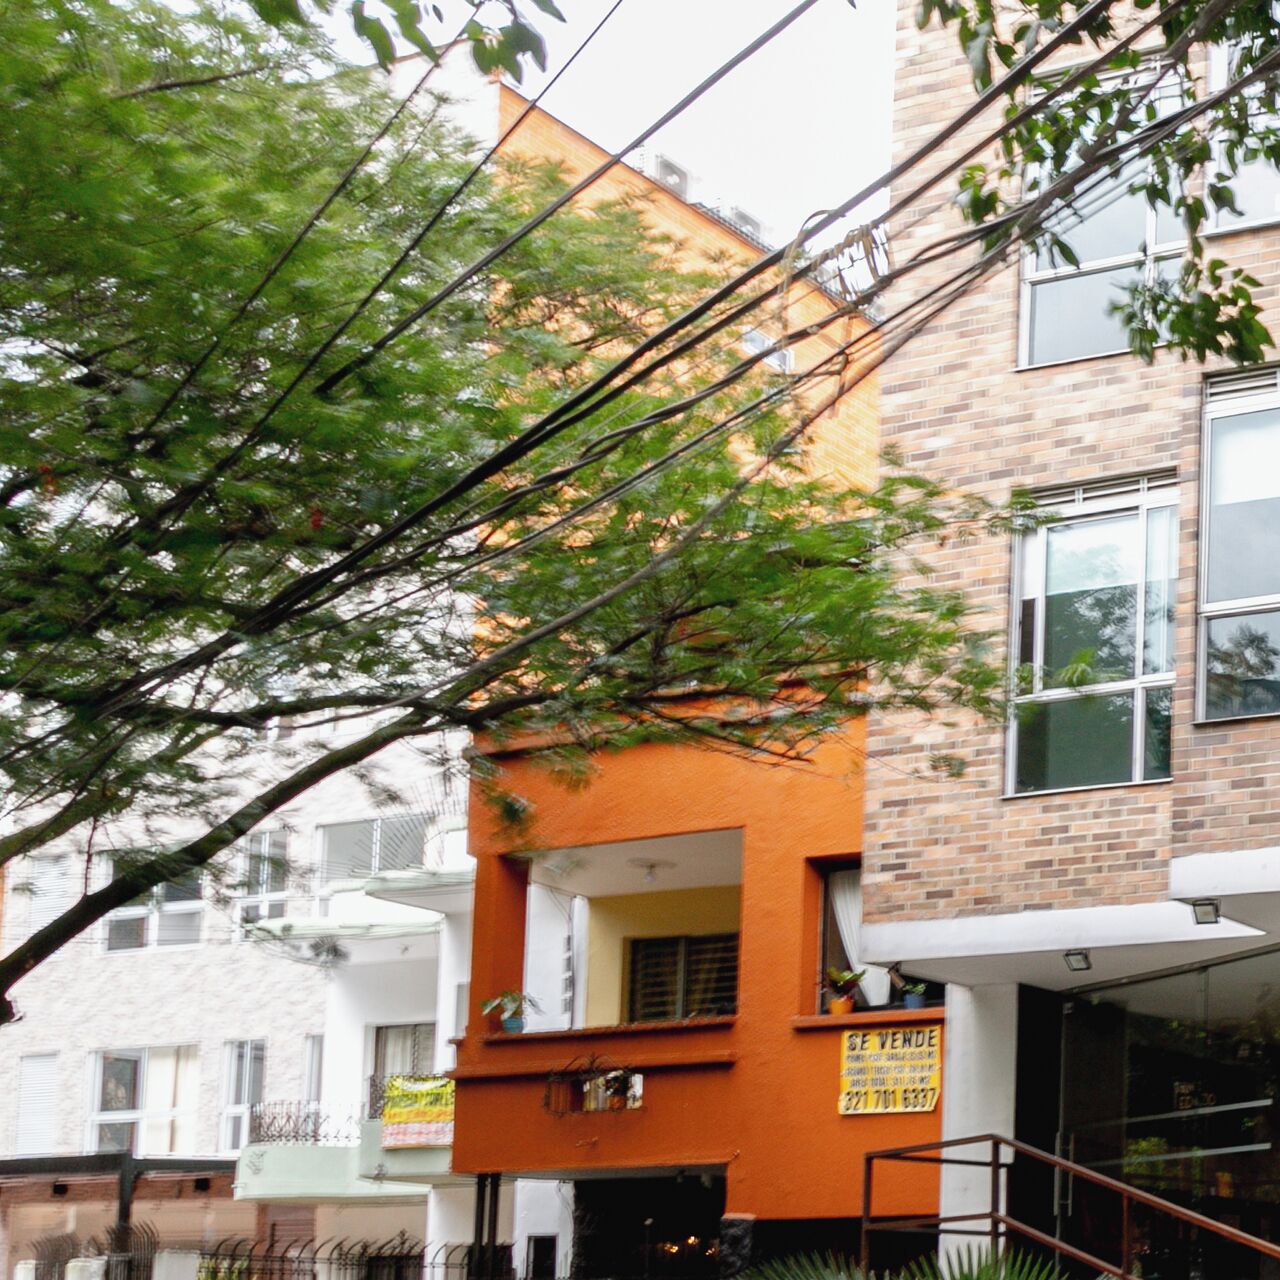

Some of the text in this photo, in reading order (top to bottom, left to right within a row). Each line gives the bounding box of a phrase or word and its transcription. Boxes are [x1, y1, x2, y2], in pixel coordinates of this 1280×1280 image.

[847, 1029, 939, 1051] SE VENDE
[844, 1087, 937, 1112] 321 701 6337
